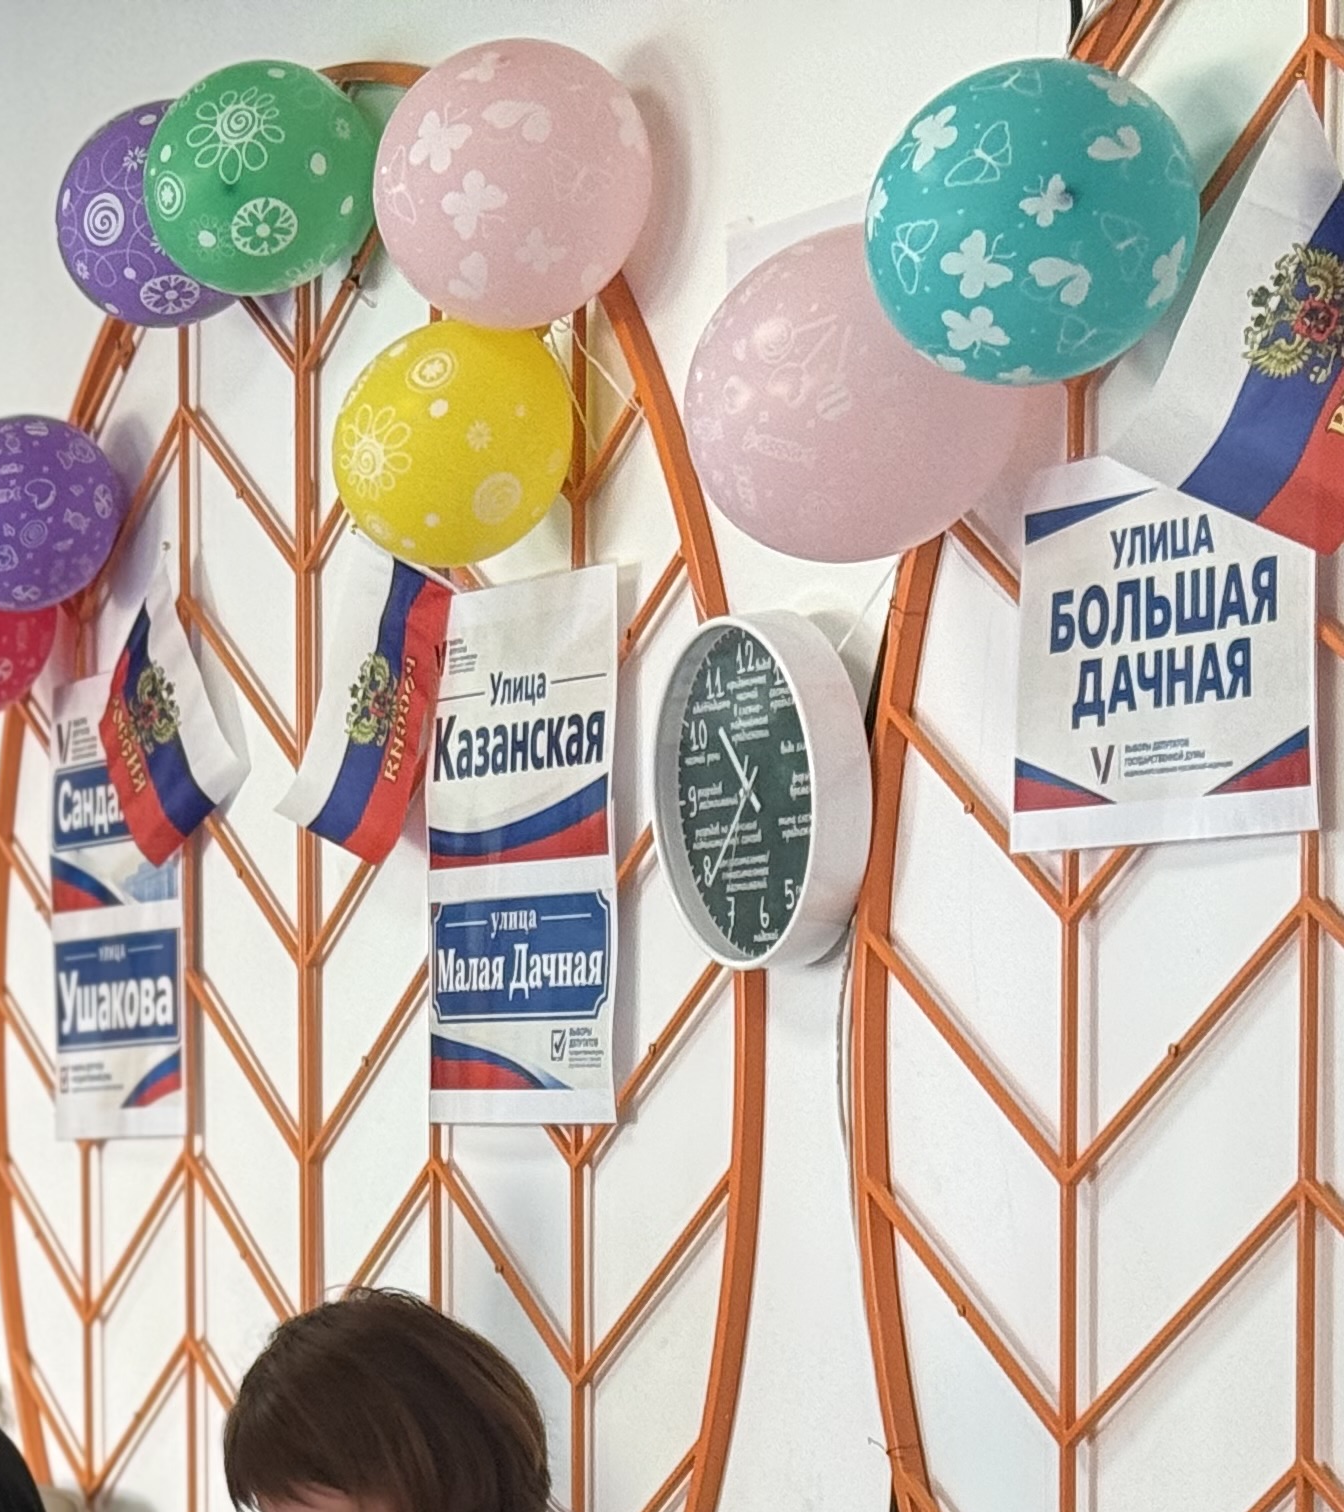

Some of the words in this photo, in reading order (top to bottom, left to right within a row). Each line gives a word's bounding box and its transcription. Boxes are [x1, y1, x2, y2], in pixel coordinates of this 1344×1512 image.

[1110, 514, 1214, 569] УЛИЦА
[1050, 555, 1278, 654] БОЛЬШАЯ
[736, 640, 755, 674] 12
[490, 671, 546, 706] Улица
[706, 667, 724, 700] 11
[1072, 637, 1251, 729] ДАЧНАЯ
[433, 710, 605, 782] Казанская
[689, 719, 708, 752] 10
[58, 780, 125, 836] Санда
[688, 785, 698, 818] 9
[702, 855, 712, 888] 8
[784, 879, 795, 910] 5
[490, 909, 538, 939] улица
[726, 896, 736, 941] 7
[759, 896, 770, 929] 6
[438, 948, 505, 993] Малая
[509, 943, 604, 1001] Дачная
[59, 970, 173, 1035] Ушакова
